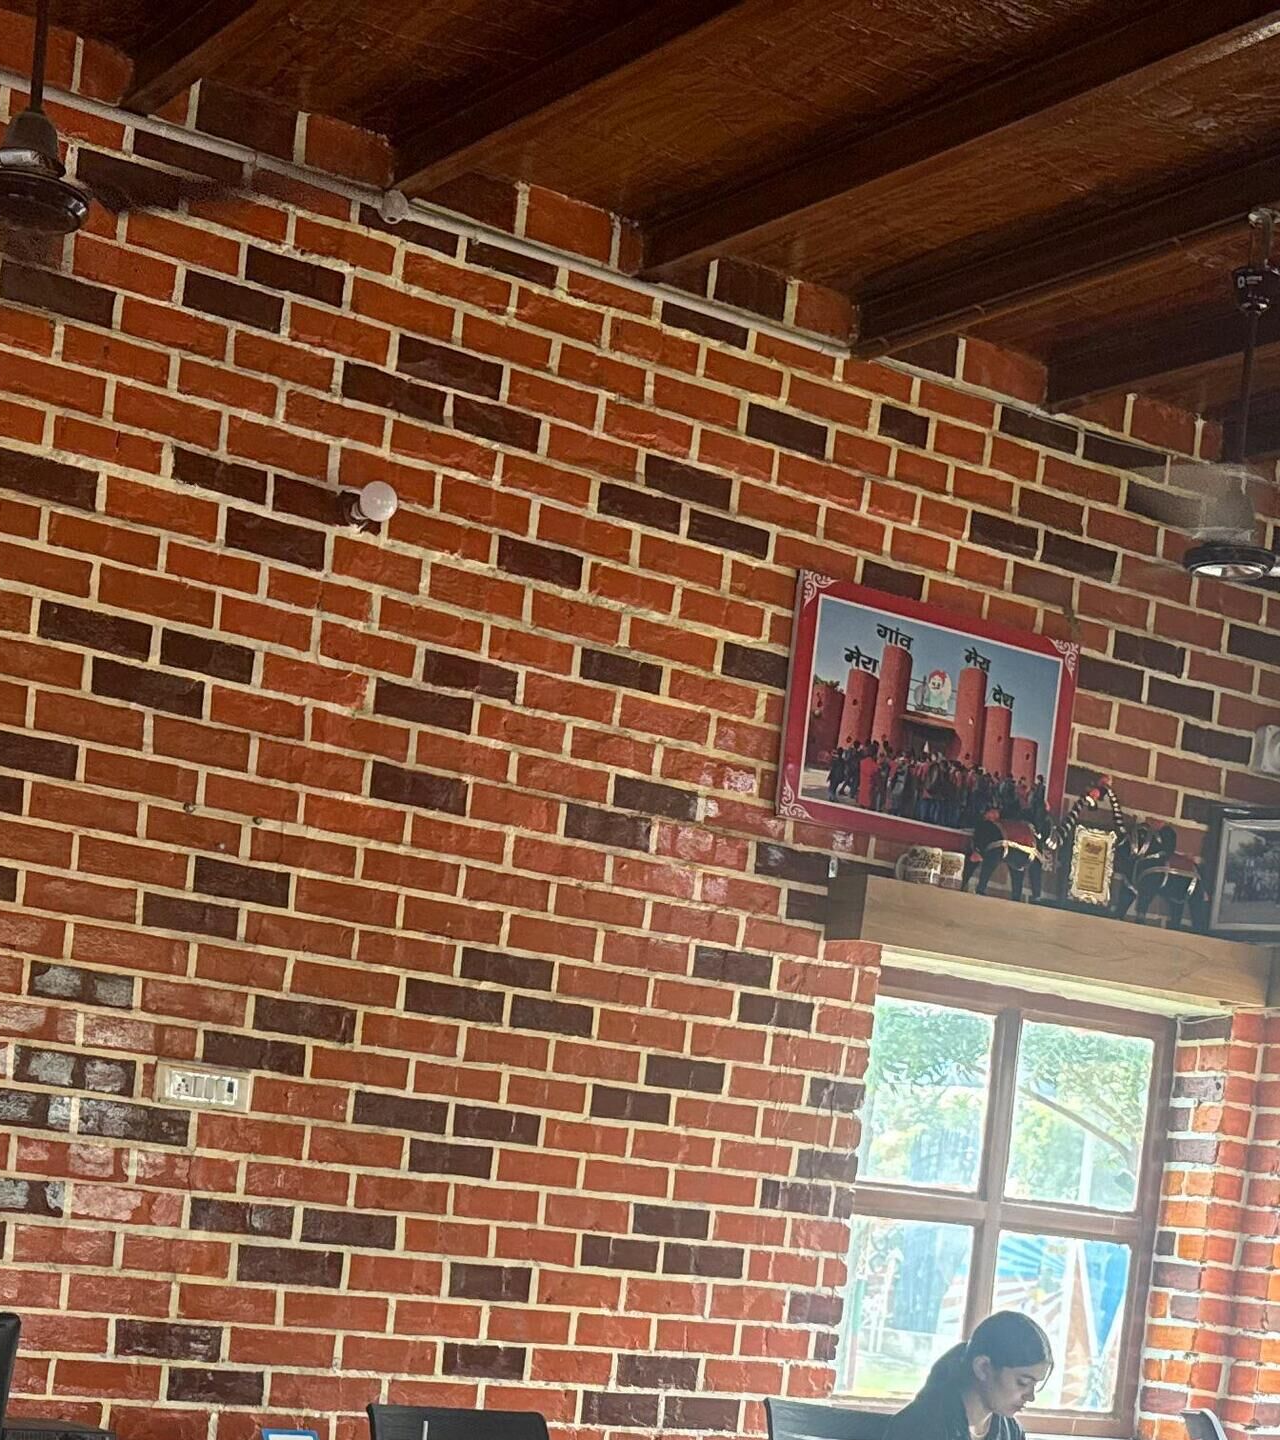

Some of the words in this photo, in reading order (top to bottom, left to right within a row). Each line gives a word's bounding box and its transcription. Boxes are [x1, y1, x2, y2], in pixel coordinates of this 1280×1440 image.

[844, 645, 880, 674] मेरा
[876, 623, 914, 651] गांव
[964, 647, 991, 674] मेरा
